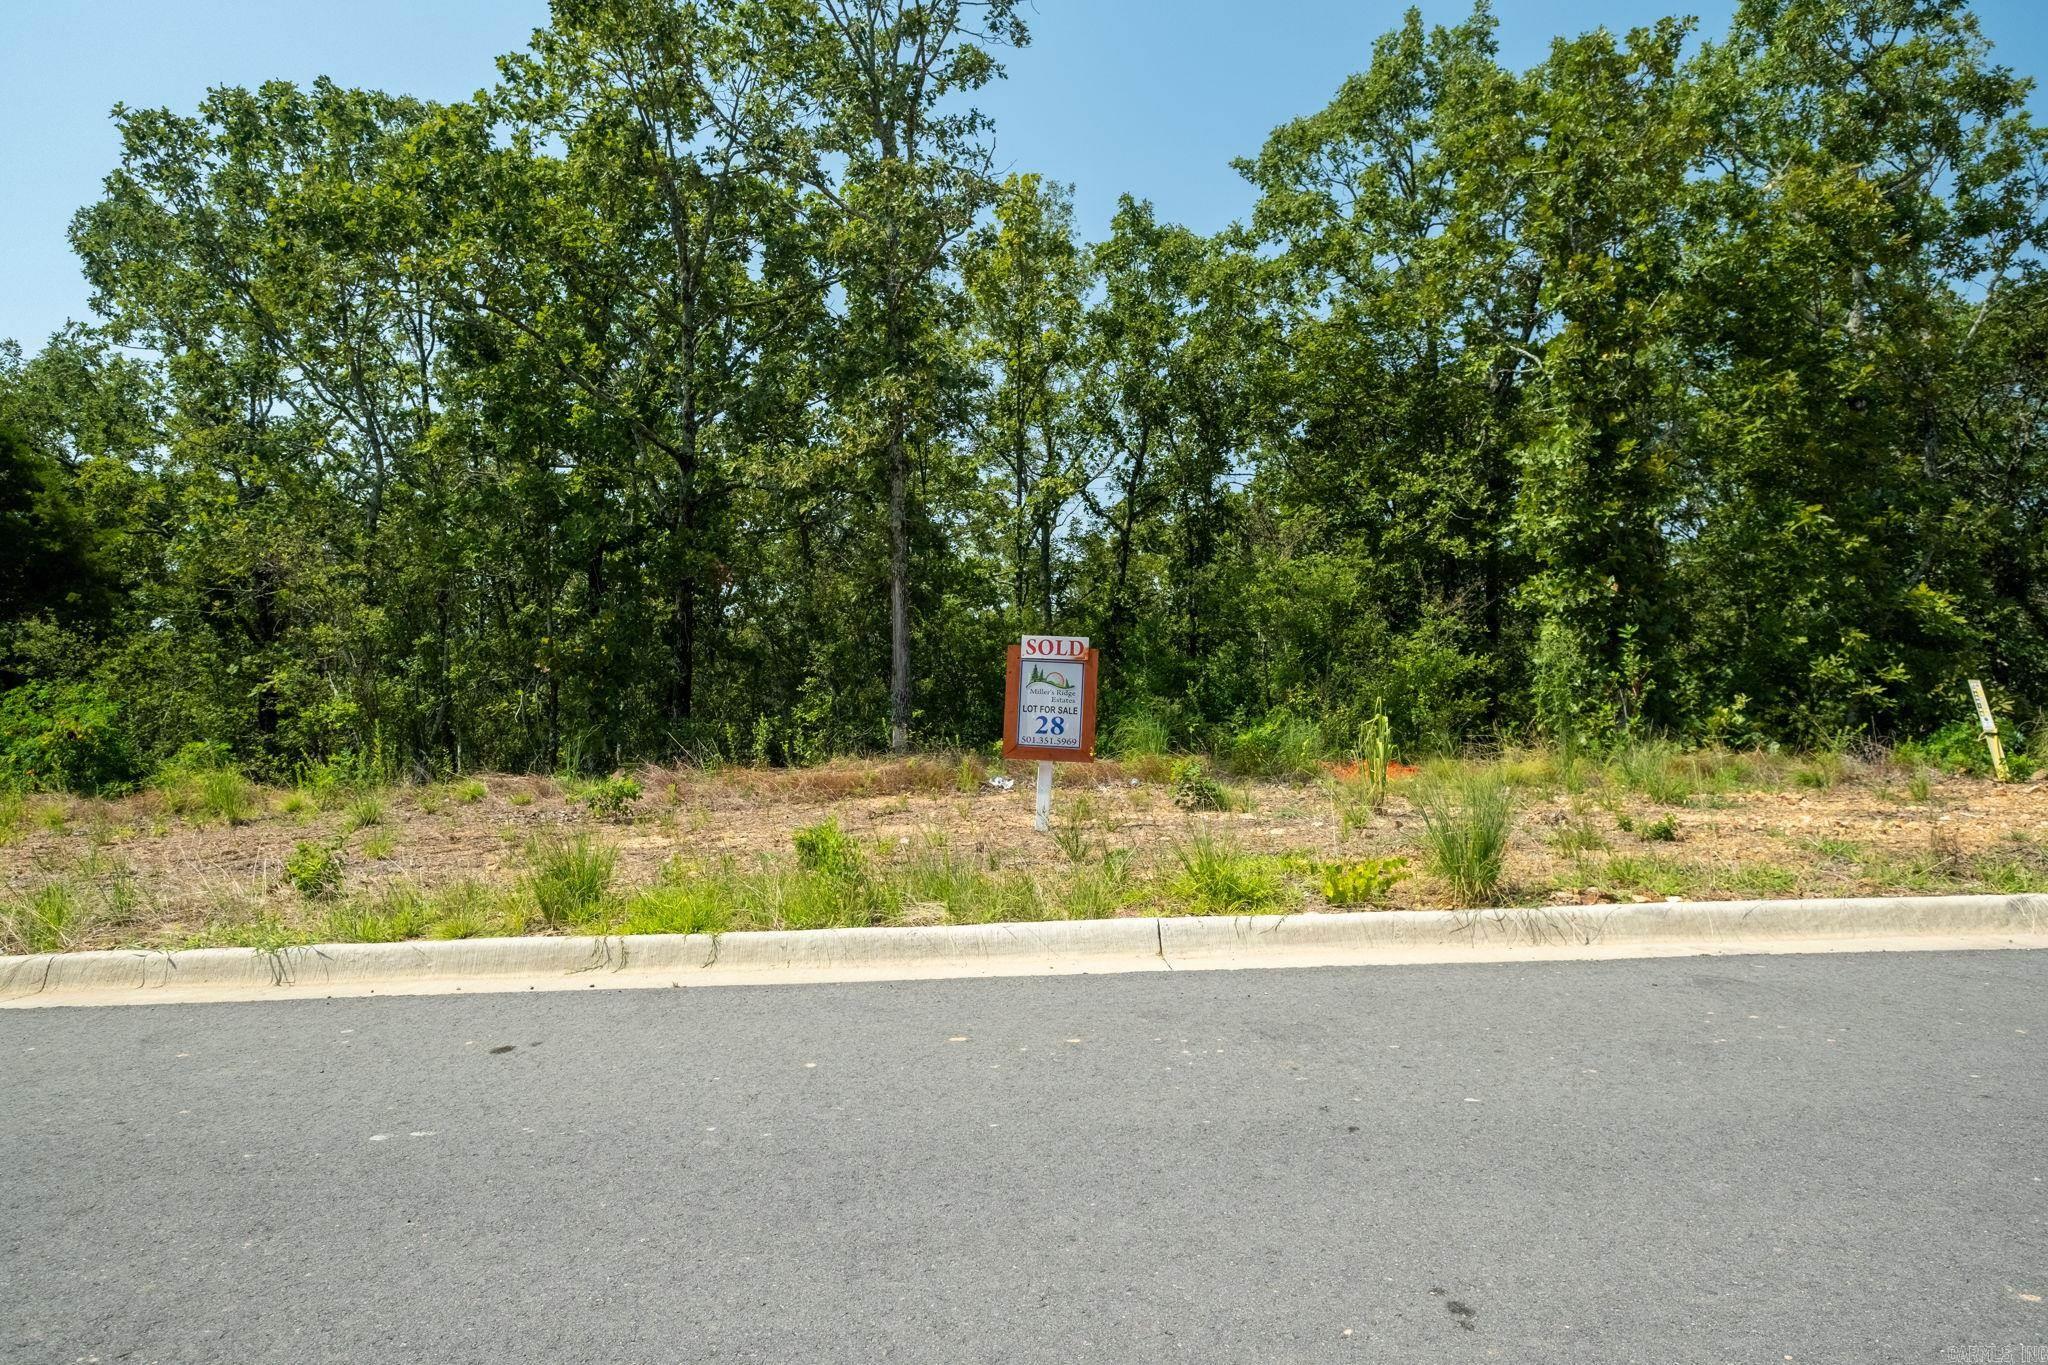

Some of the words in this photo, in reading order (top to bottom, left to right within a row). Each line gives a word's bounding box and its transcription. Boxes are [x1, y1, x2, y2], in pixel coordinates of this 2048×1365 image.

[1026, 638, 1085, 656] SOLD
[1029, 688, 1055, 696] Miller's
[1056, 689, 1076, 699] Ridge
[1051, 696, 1076, 704] Estates
[1022, 705, 1039, 713] LOT
[1039, 705, 1056, 714] FOR
[1057, 706, 1078, 715] SALE
[1035, 715, 1064, 735] 28
[1021, 735, 1077, 746] 501.351.5969
